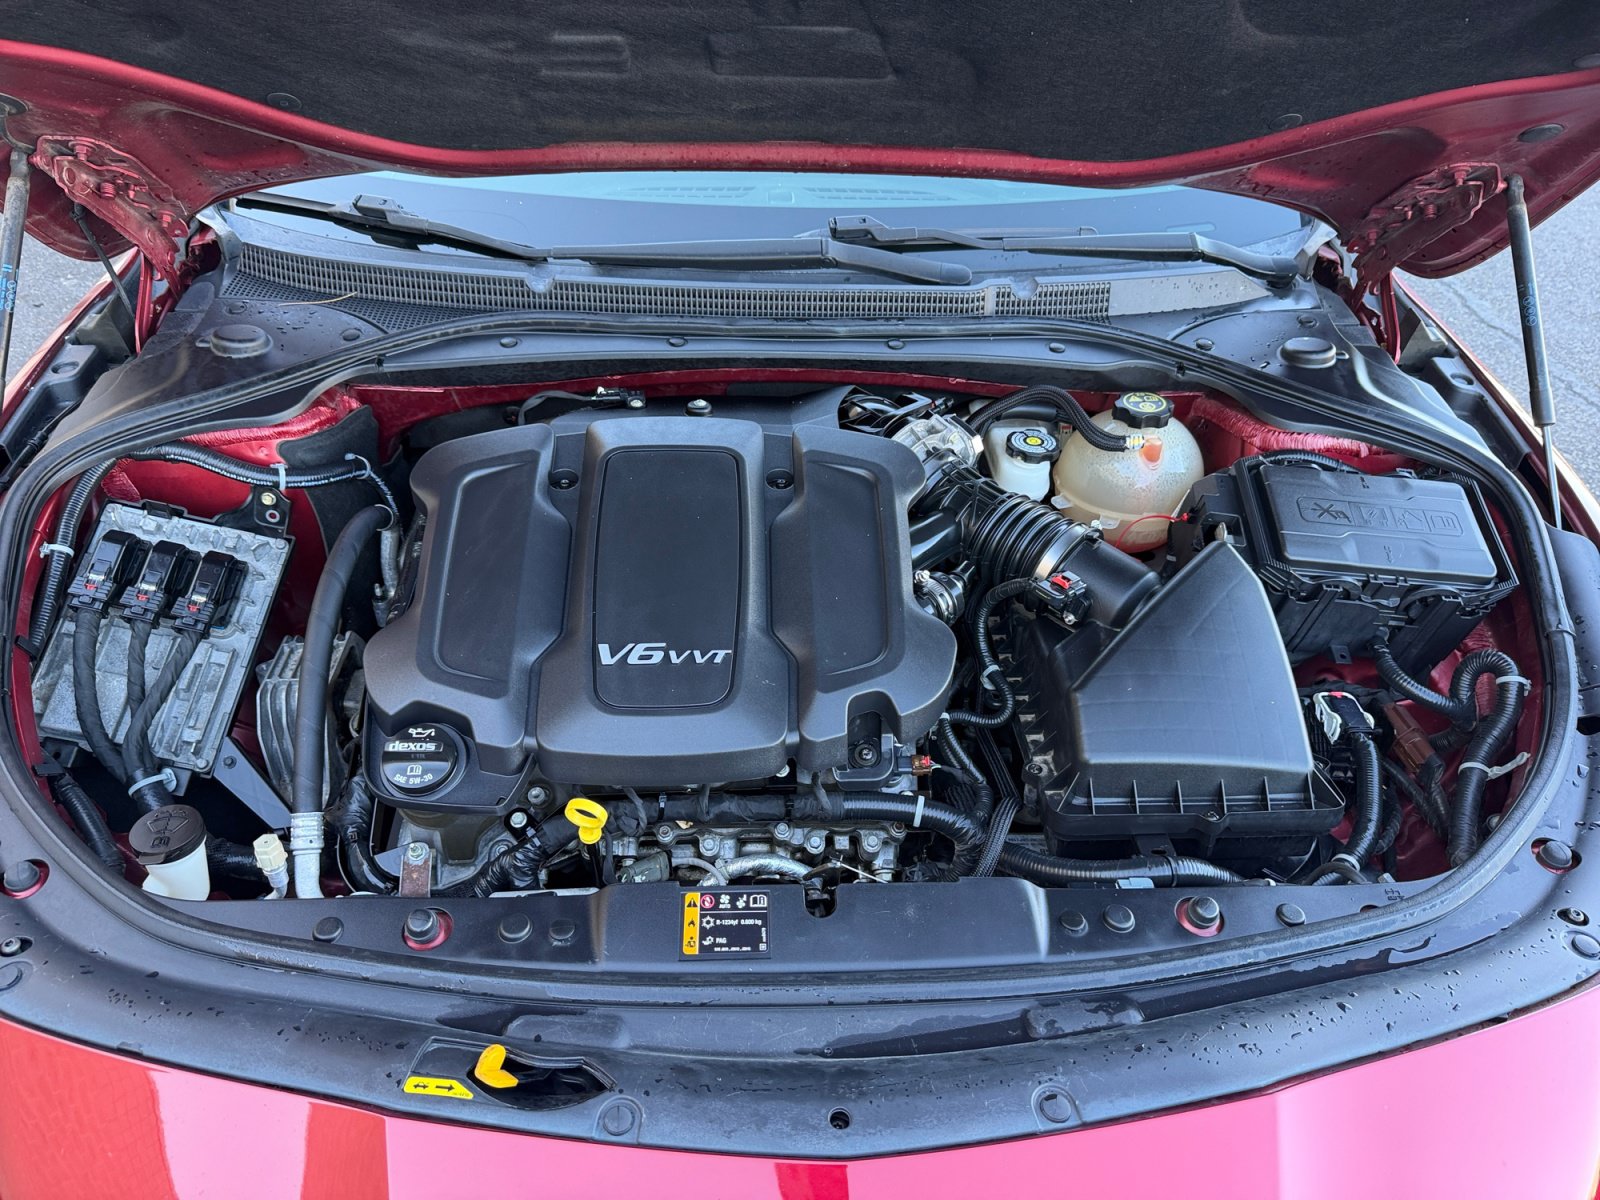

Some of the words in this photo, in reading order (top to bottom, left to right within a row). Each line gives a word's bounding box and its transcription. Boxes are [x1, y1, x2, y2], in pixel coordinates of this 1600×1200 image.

[597, 643, 666, 665] V6
[669, 650, 732, 664] VVT
[389, 741, 436, 751] dexos
[393, 774, 408, 783] SAE
[409, 773, 433, 784] 5W-30
